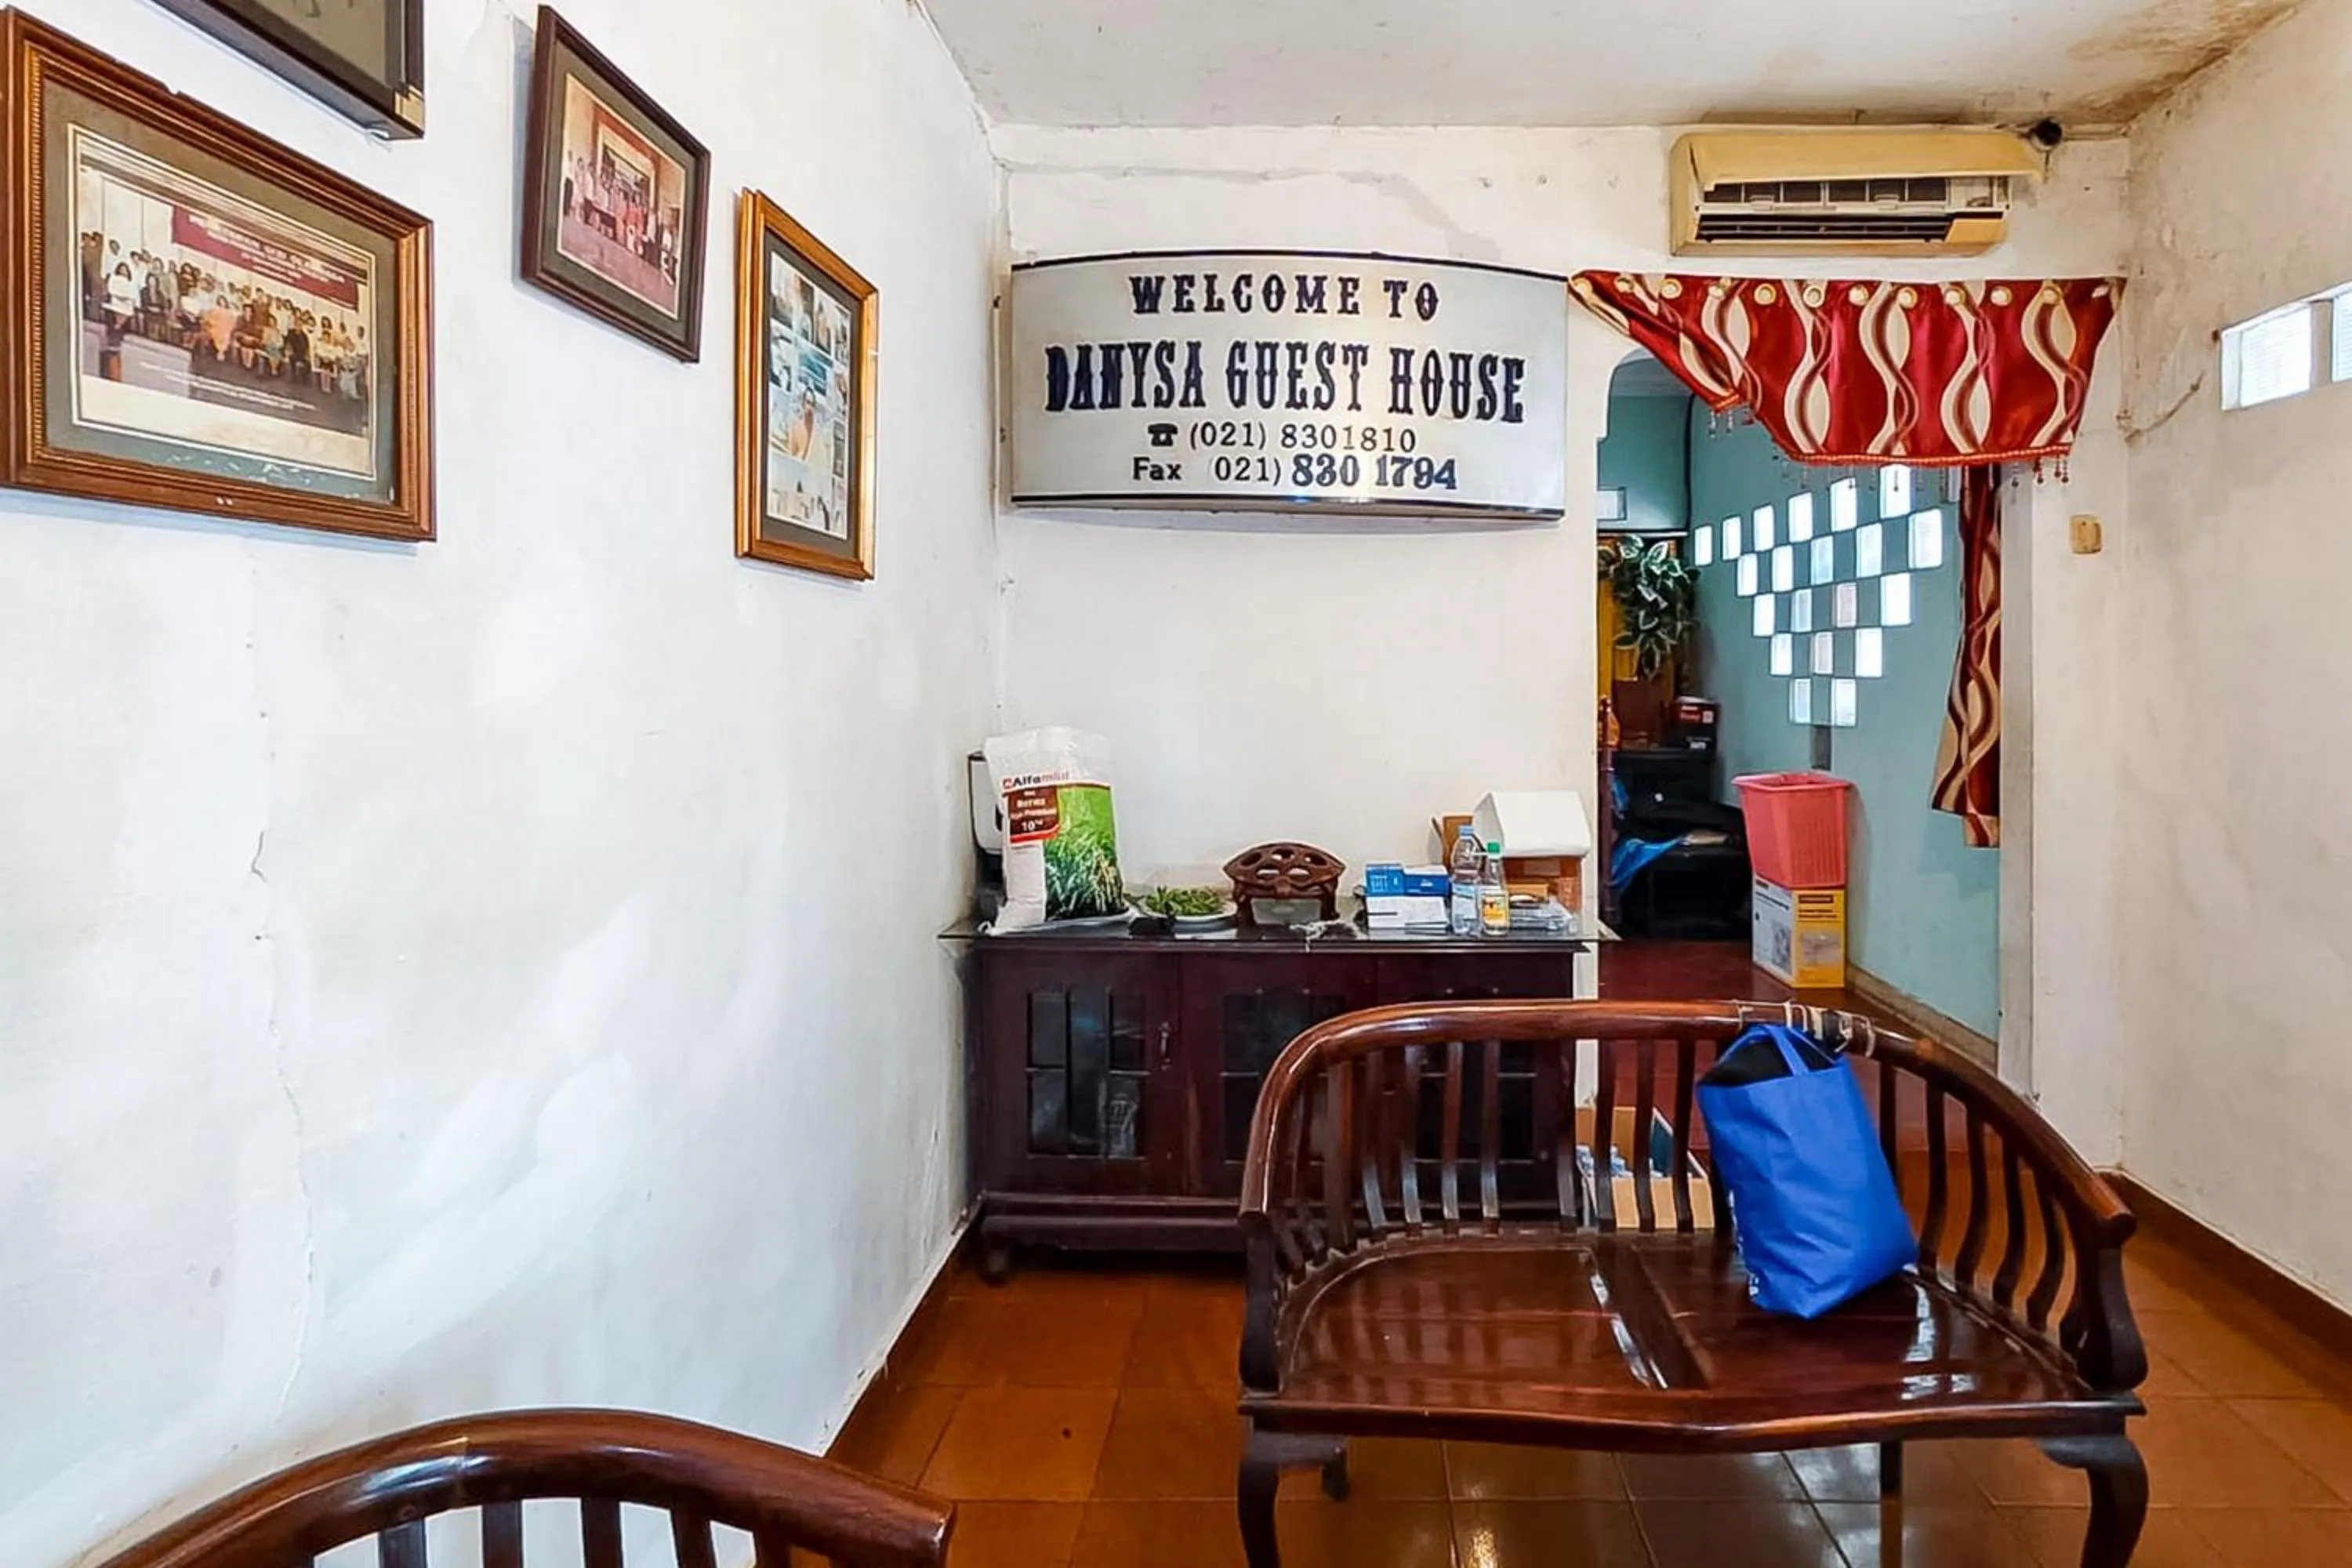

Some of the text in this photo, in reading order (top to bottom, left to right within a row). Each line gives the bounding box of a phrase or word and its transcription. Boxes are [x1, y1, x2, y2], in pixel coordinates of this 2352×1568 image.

[1128, 274, 1439, 321] WELCOME TO
[1044, 339, 1526, 423] DANYSA GUEST HOUSE
[1189, 421, 1417, 452] (021) 8301810
[1132, 456, 1182, 481] Fax
[1291, 453, 1360, 487] 830
[1375, 454, 1457, 490] 1794
